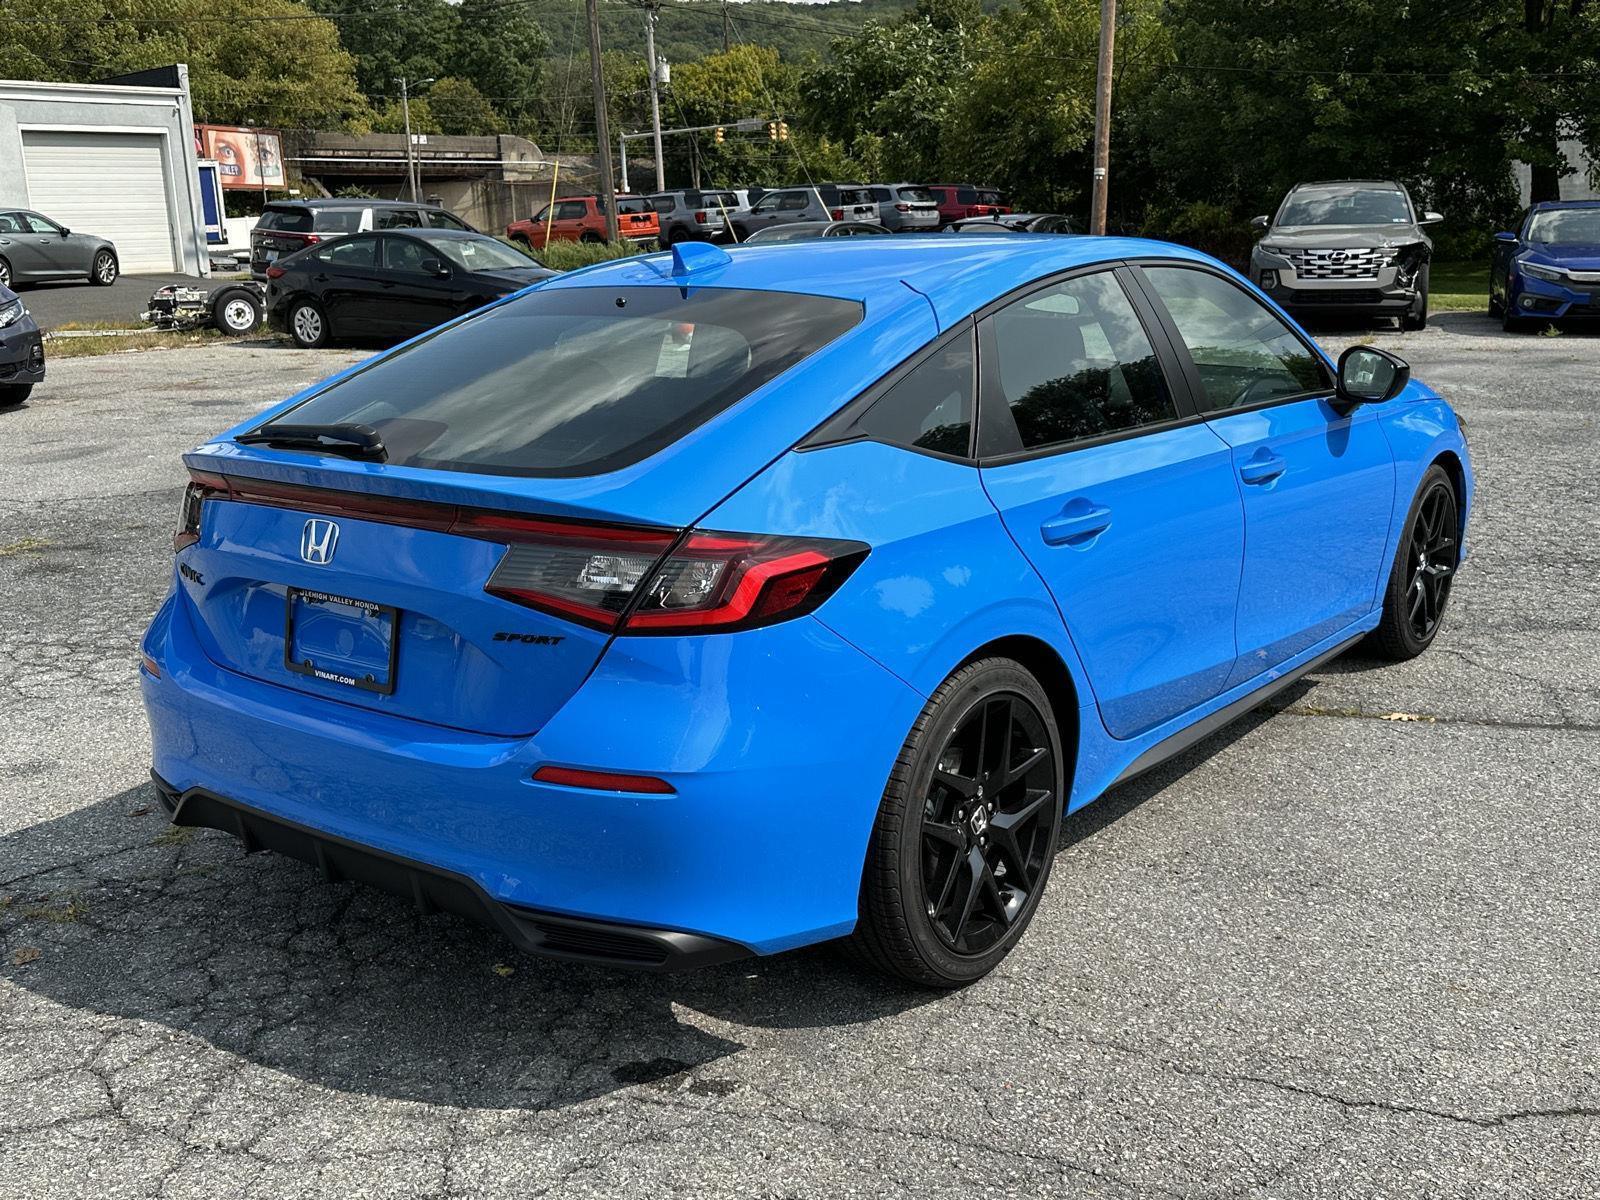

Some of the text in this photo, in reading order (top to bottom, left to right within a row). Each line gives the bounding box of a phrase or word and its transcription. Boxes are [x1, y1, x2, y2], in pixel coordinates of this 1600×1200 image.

[305, 591, 380, 611] LEHIGH VALLEY HONDA
[492, 632, 566, 645] SPORT
[314, 669, 356, 686] VINART.COM
